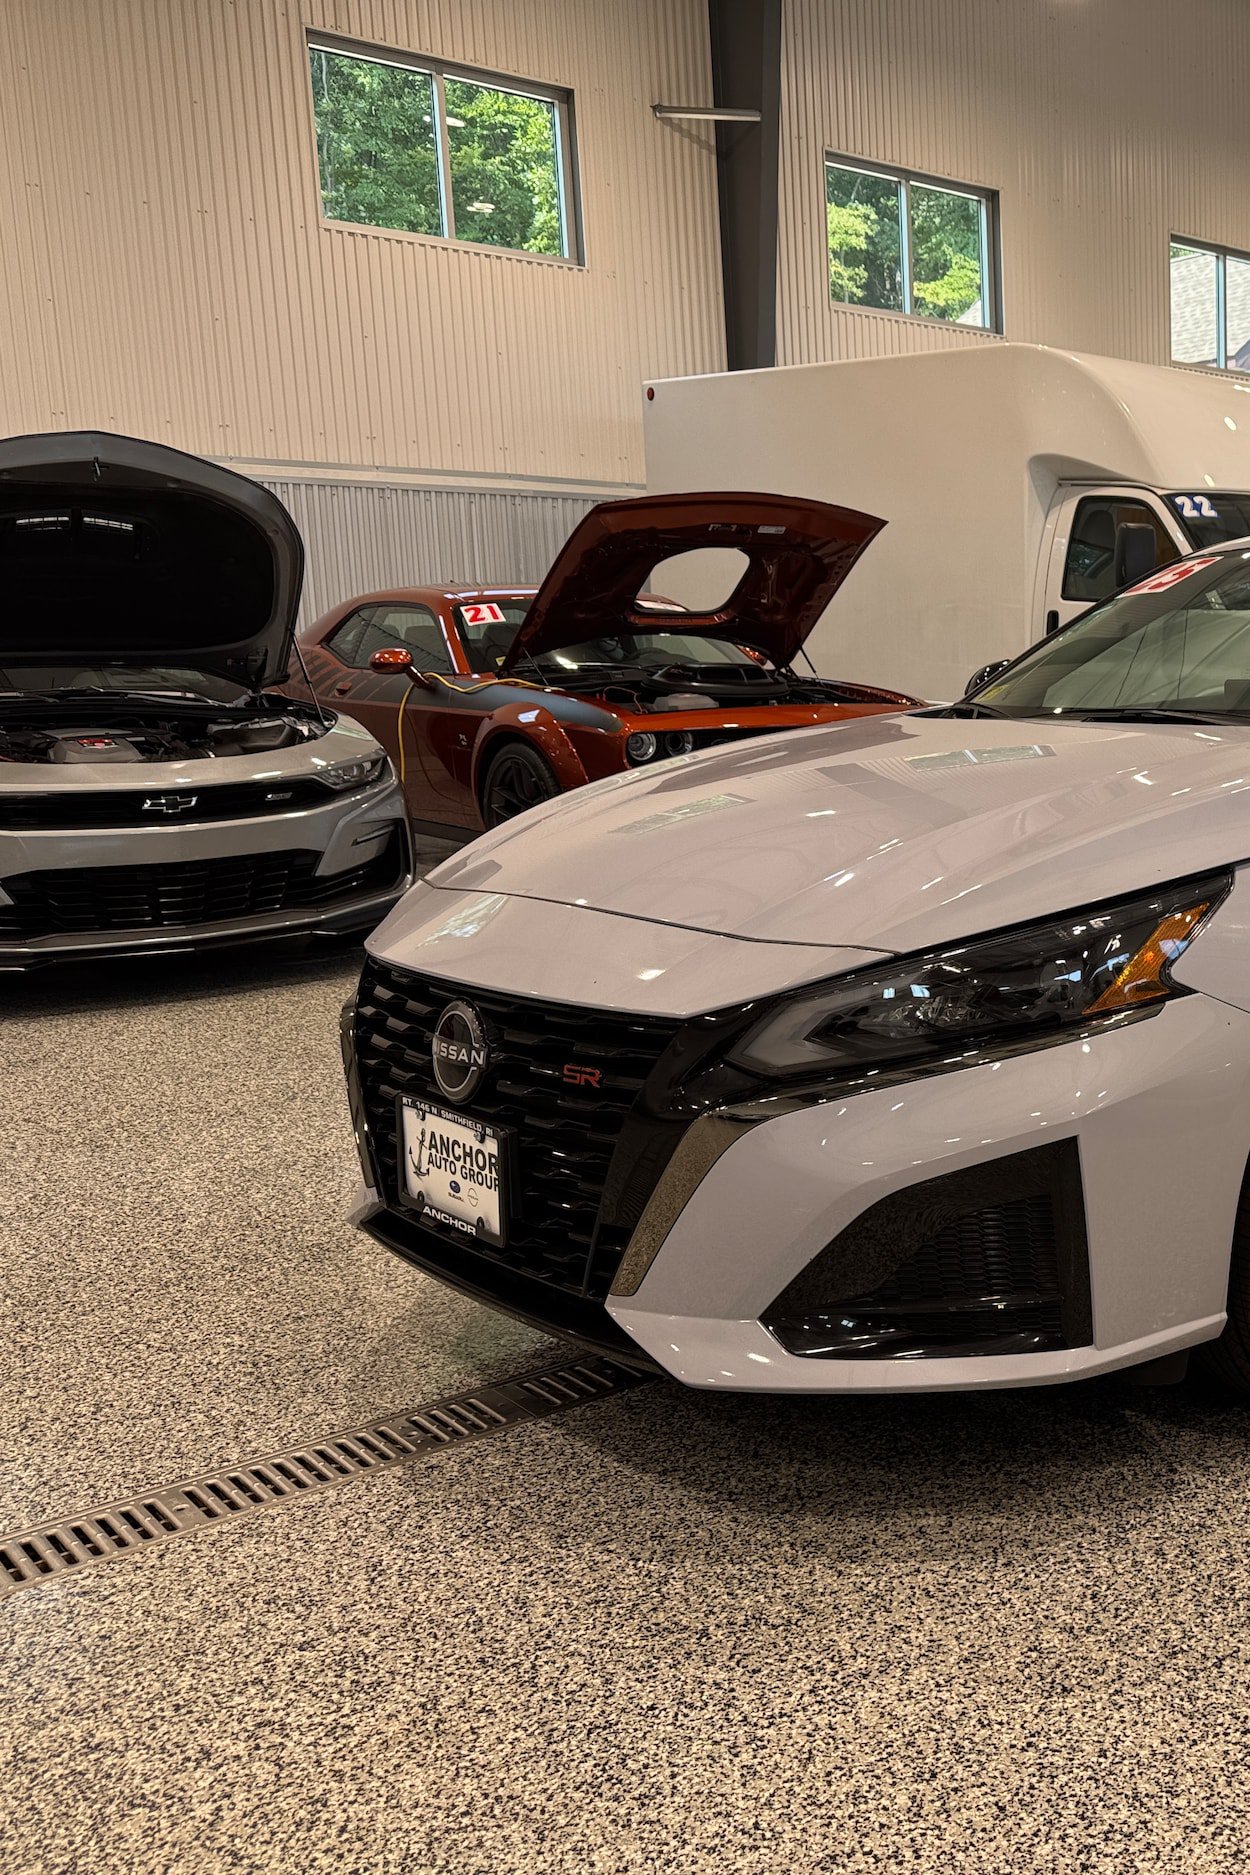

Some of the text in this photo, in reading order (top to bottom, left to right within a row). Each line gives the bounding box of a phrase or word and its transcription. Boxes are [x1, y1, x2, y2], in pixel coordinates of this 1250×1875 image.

[1175, 495, 1218, 518] 22
[1124, 558, 1218, 594] 25
[464, 605, 499, 623] 21
[563, 1063, 602, 1088] SR
[416, 1101, 430, 1112] 146
[485, 1127, 494, 1137] RI
[428, 1131, 499, 1177] ANCHOR
[427, 1152, 499, 1192] AUTO GROUP
[422, 1205, 476, 1236] ANCHOR
